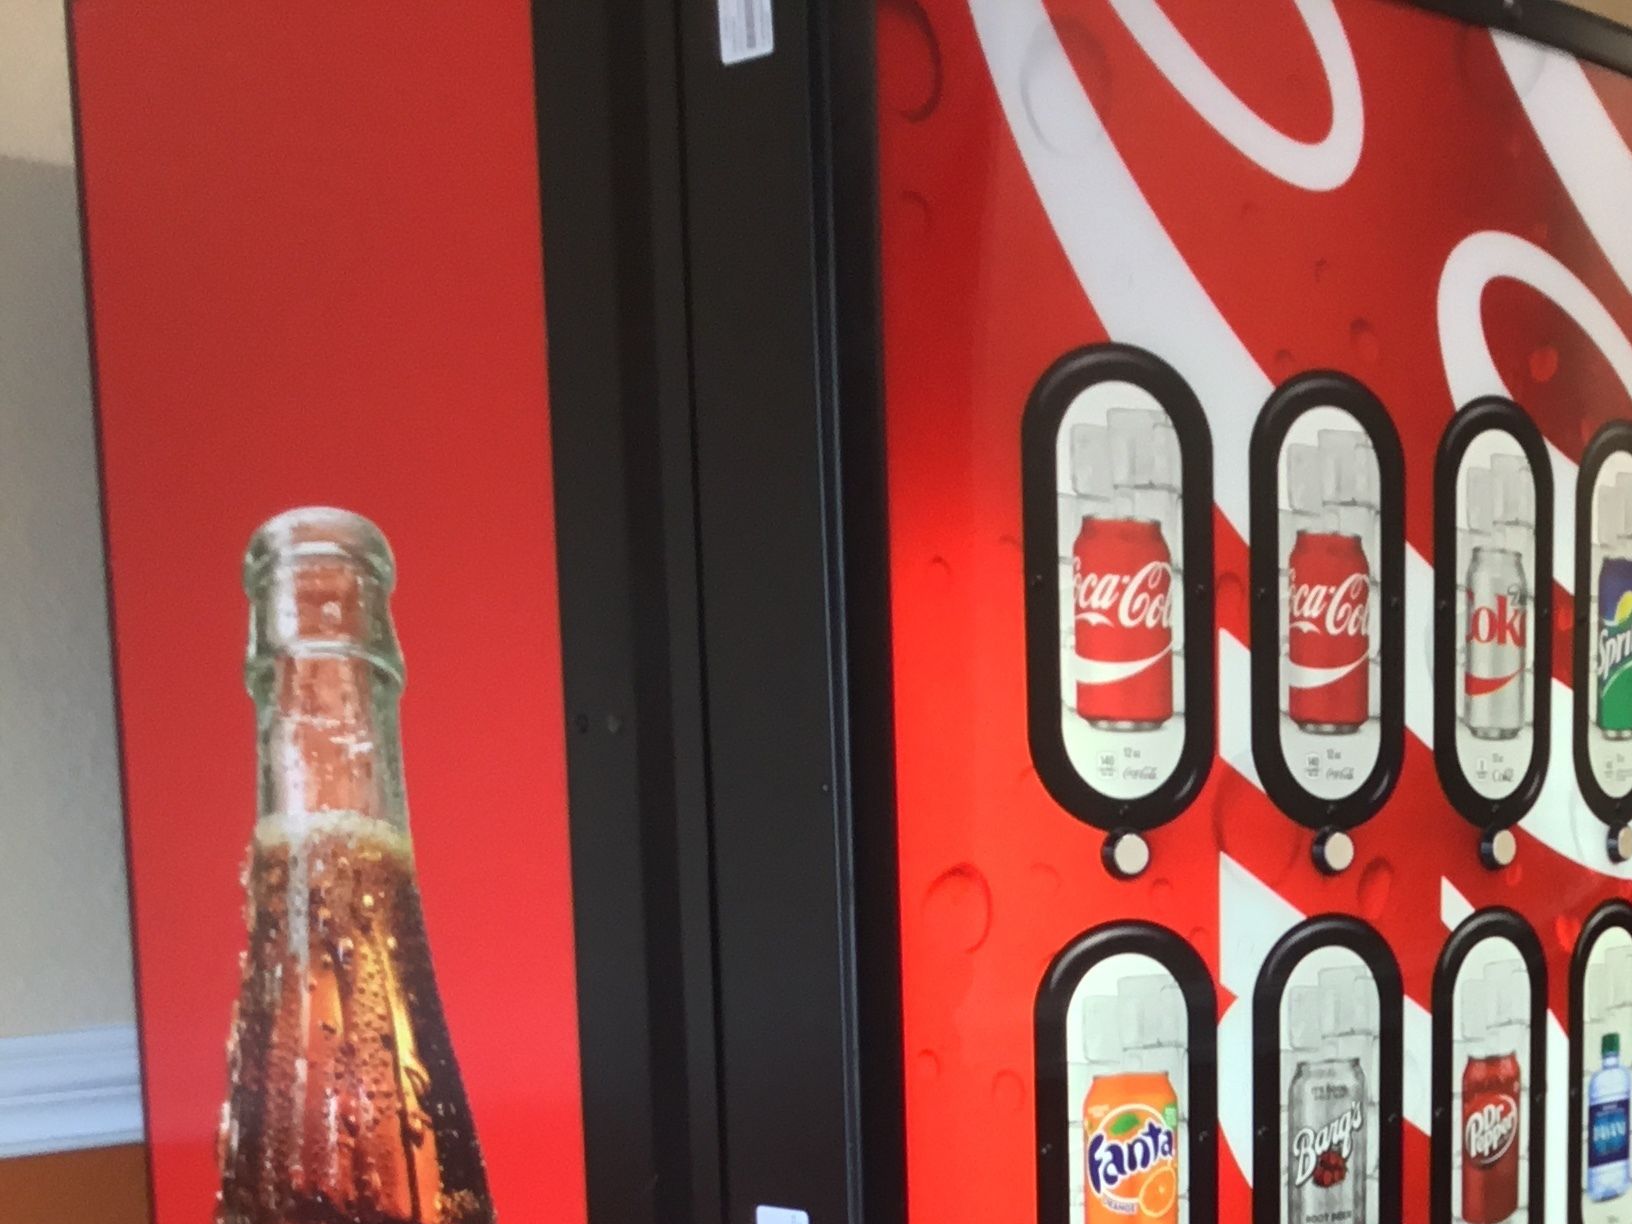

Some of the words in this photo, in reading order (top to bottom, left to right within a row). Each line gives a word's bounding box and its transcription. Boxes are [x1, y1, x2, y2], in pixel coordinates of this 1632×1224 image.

[1293, 1101, 1363, 1186] Barq's
[1483, 1104, 1505, 1131] Dr
[1088, 1120, 1174, 1194] Fanta
